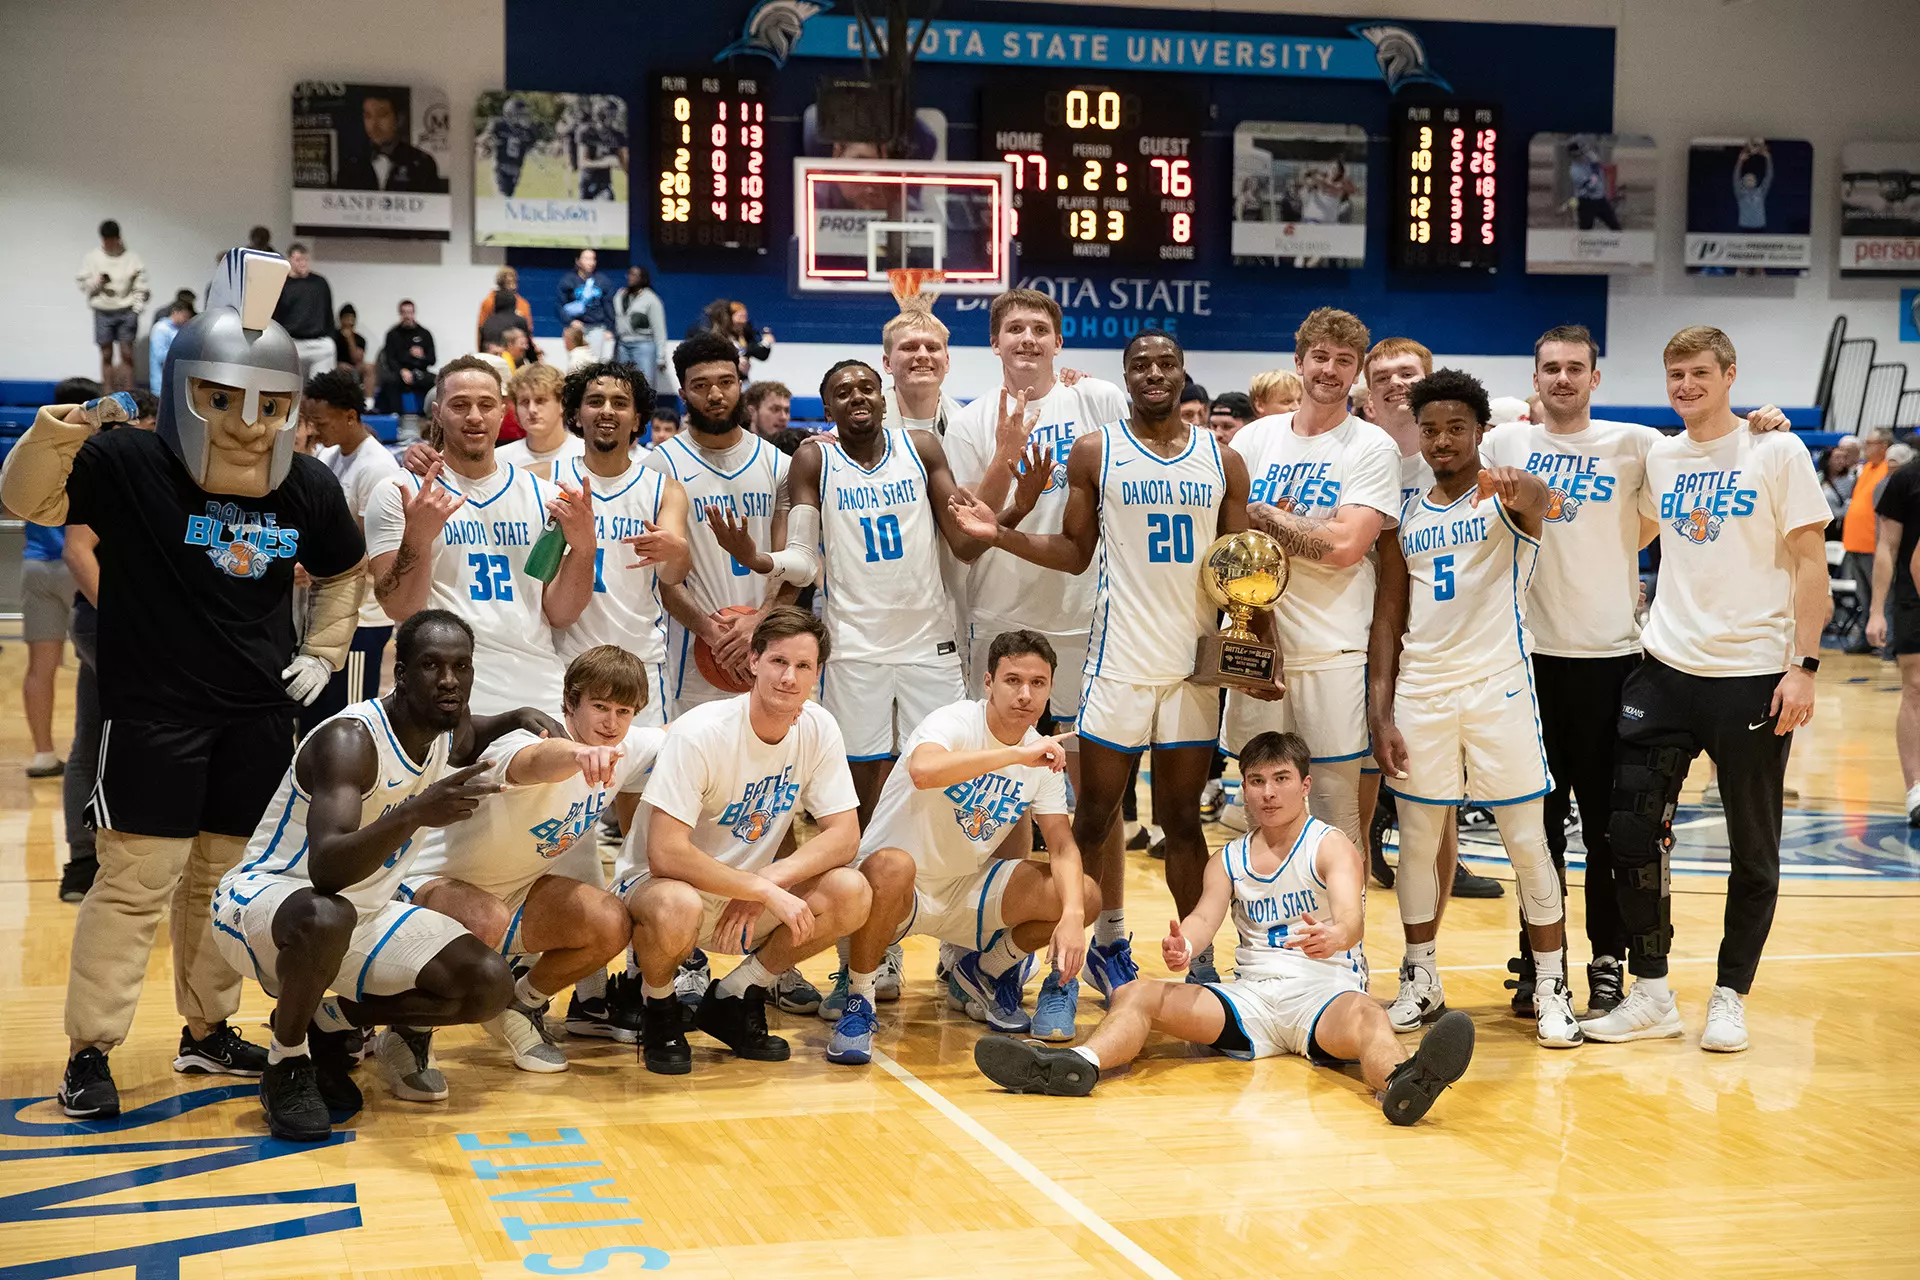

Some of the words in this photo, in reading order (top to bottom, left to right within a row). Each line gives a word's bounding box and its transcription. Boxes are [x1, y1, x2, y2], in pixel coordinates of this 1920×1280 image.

[1002, 31, 1109, 61] STATE
[1127, 36, 1334, 71] UNIVERSITY
[674, 97, 690, 121] 0
[719, 101, 727, 121] 1
[740, 102, 763, 122] 11
[1066, 90, 1121, 130] 0.0
[682, 123, 690, 144] 1
[711, 123, 727, 147] 0
[740, 125, 763, 148] 13
[996, 131, 1043, 151] HOME
[1139, 136, 1190, 156] GUEST
[1420, 126, 1432, 149] 3
[1450, 128, 1464, 150] 2
[1476, 129, 1496, 151] 12
[674, 147, 690, 171] 2
[711, 150, 727, 173] 0
[748, 150, 763, 174] 2
[1073, 143, 1112, 158] PERIOD
[1411, 149, 1432, 172] 10
[1450, 151, 1464, 173] 2
[1470, 151, 1496, 174] 26
[659, 171, 690, 196] 20
[713, 173, 727, 197] 3
[740, 175, 763, 198] 10
[1004, 154, 1047, 190] 77
[1083, 160, 1102, 191] 2
[1150, 159, 1191, 197] 76
[1411, 175, 1431, 195] 11
[1450, 175, 1463, 197] 2
[1475, 176, 1495, 198] 18
[321, 194, 424, 212] SANFORD
[505, 201, 597, 222] Madison
[661, 197, 690, 222] 32
[711, 201, 727, 221] 4
[740, 200, 763, 223] 12
[1057, 196, 1098, 211] PLAYER
[1103, 197, 1131, 211] FOUL
[1161, 199, 1195, 214] FOULS
[1410, 196, 1431, 219] 12
[1450, 198, 1462, 220] 3
[1483, 199, 1495, 221] 3
[1071, 210, 1096, 240] 13
[1107, 211, 1124, 241] 3
[1173, 213, 1190, 242] 8
[1410, 220, 1431, 243] 13
[1450, 222, 1462, 244] 3
[1481, 222, 1494, 245] 5
[1073, 242, 1110, 258] MATCH
[1160, 244, 1194, 259] SCORE
[1108, 278, 1212, 316] STATE
[1266, 462, 1332, 482] BATTLE
[1525, 452, 1600, 476] BATTLE
[836, 486, 879, 511] DAKOTA
[882, 479, 917, 504] STATE
[1122, 479, 1174, 505] DAKOTA
[1179, 480, 1213, 509] STATE
[1247, 478, 1342, 508] BLUES
[1674, 470, 1742, 494] BATTLE
[1661, 489, 1758, 519] BLUES
[184, 514, 299, 558] BLUES
[493, 521, 530, 546] STATE
[860, 513, 904, 563] 10
[1147, 513, 1194, 564] 20
[1265, 518, 1324, 562] TEXAS
[1402, 525, 1446, 558] DAKOTA
[1452, 516, 1488, 546] STATE
[468, 552, 514, 602] 32
[1433, 554, 1455, 602] 5
[1622, 704, 1645, 718] TROJANS
[717, 784, 800, 826] BLUES
[1282, 889, 1319, 919] STATE
[455, 1126, 671, 1276] STATE
